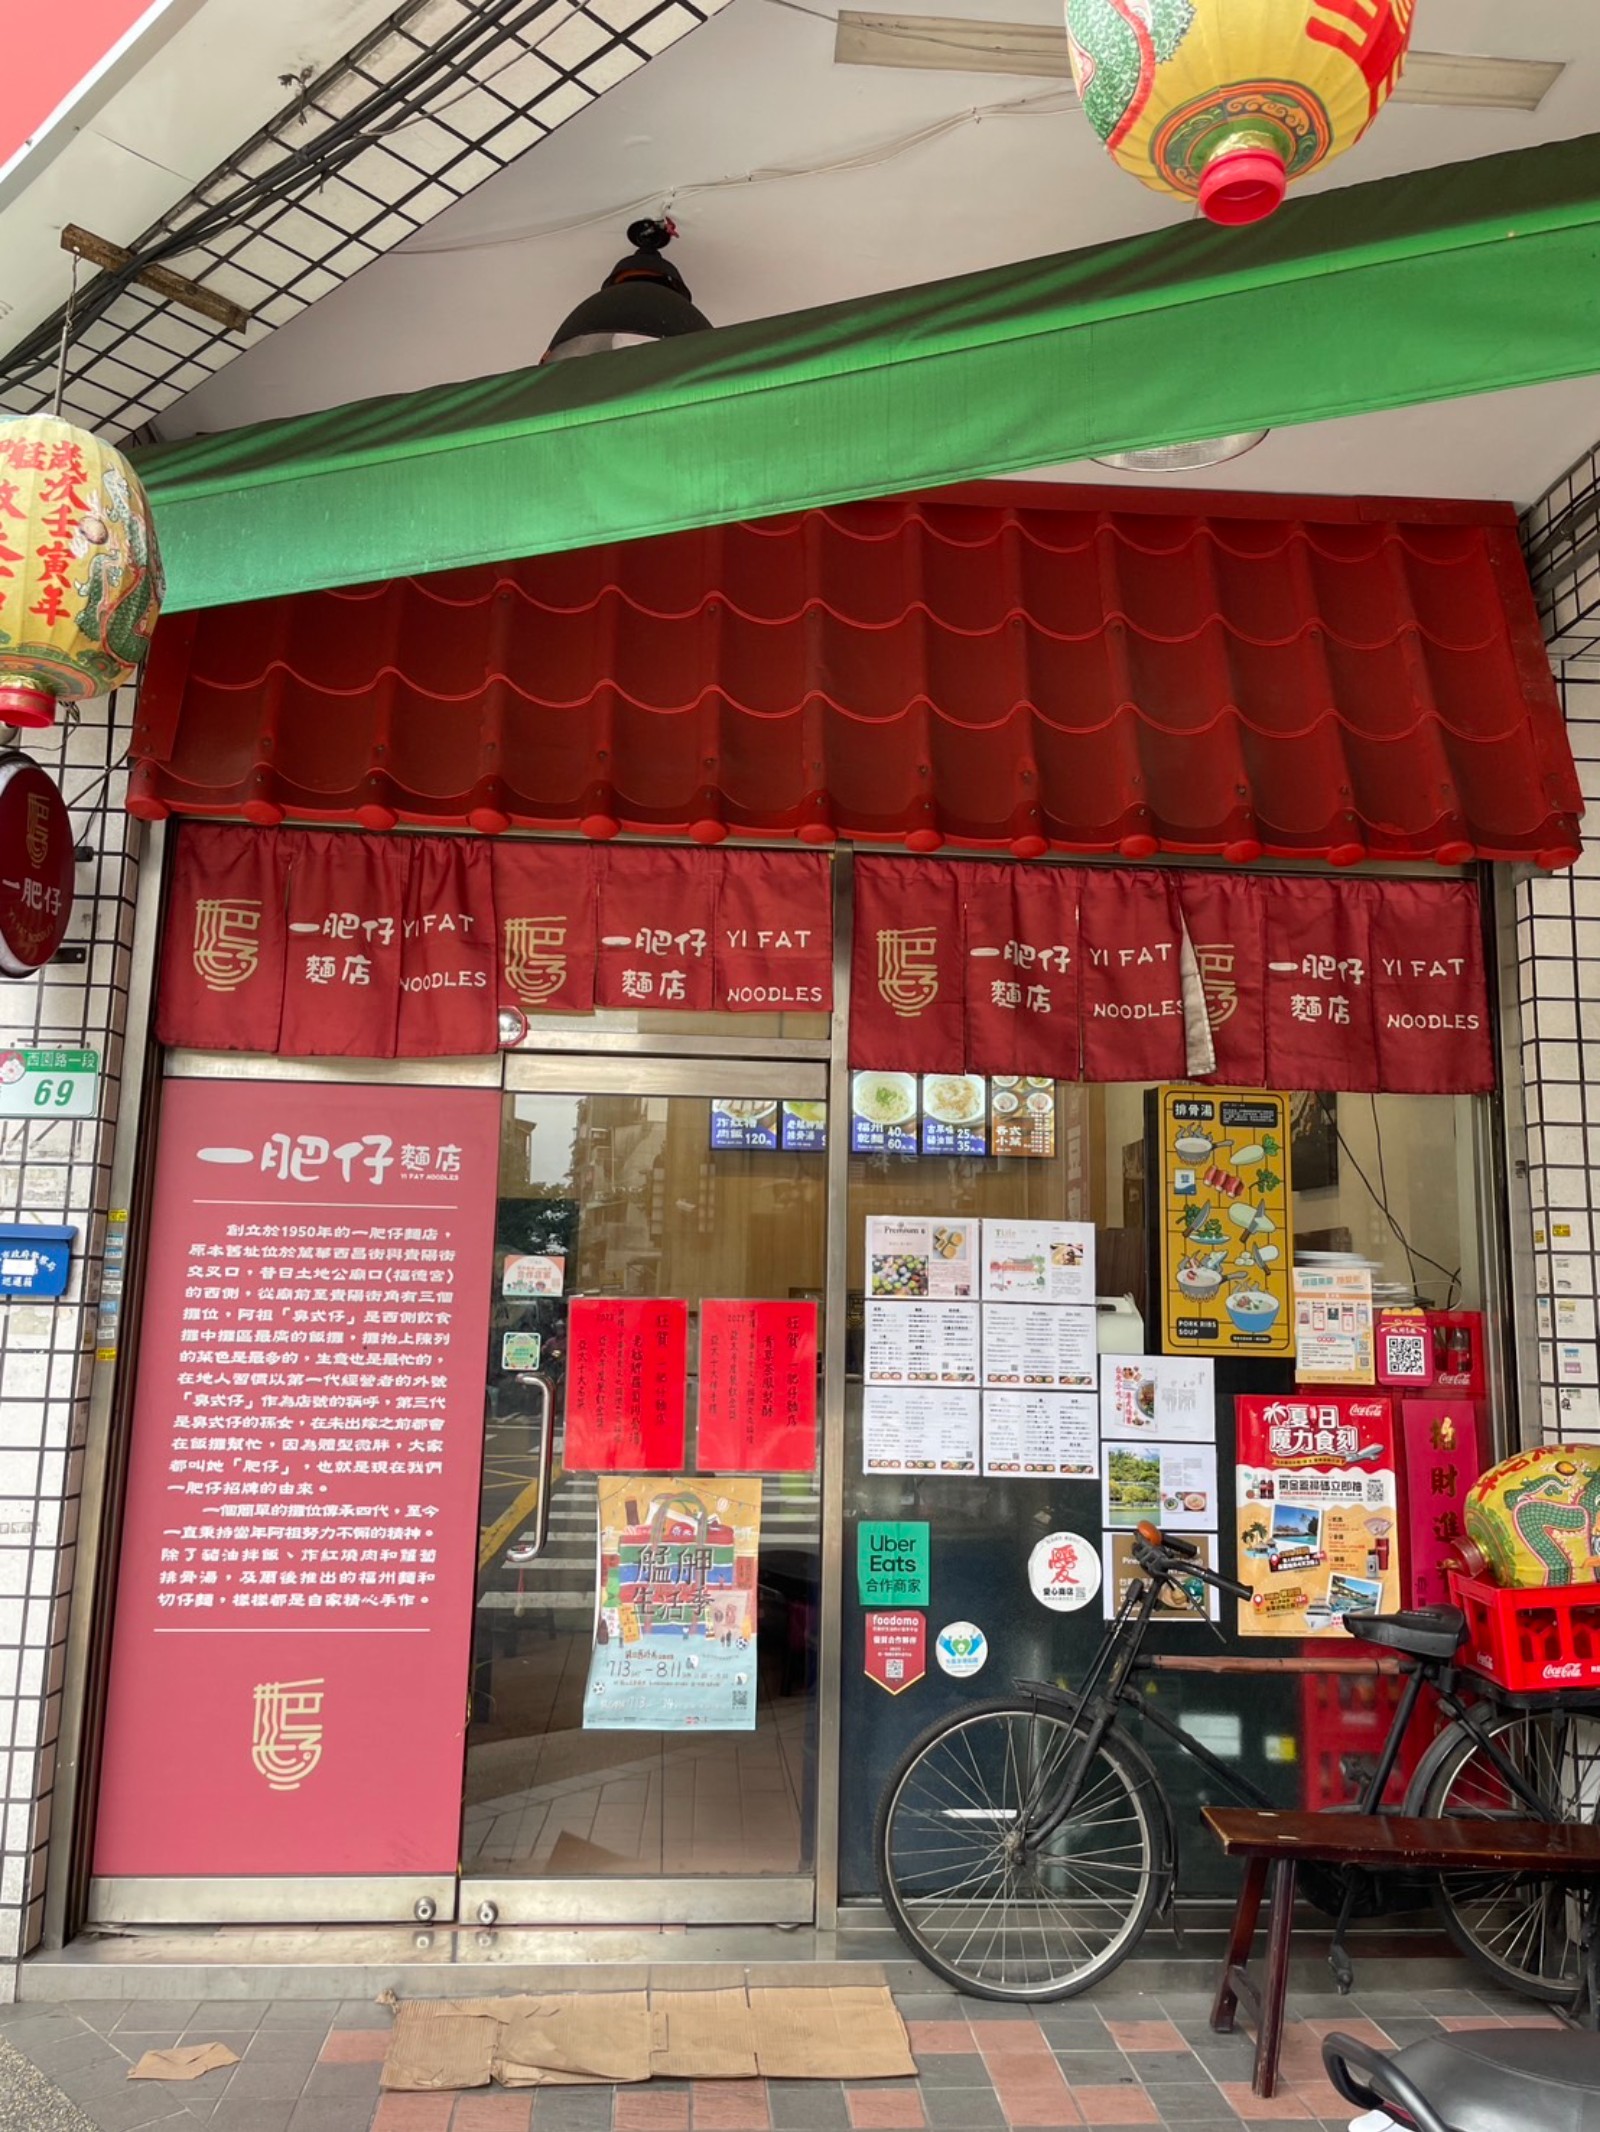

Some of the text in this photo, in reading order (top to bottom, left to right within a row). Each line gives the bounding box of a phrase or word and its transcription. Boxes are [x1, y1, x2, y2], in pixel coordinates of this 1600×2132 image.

[28, 440, 90, 627] 歲次壬寅年
[2, 878, 62, 916] 一肥仔
[289, 913, 394, 946] 一肥仔
[403, 913, 474, 940] YI FAT
[601, 927, 707, 957] 一肥仔
[727, 930, 811, 949] YI FAT
[970, 939, 1071, 974] 一肥仔
[1090, 943, 1172, 967] YI FAT
[305, 954, 372, 986] 麵店
[1268, 953, 1365, 985] 一肥仔
[1382, 958, 1465, 978] YI FAT
[621, 968, 686, 1001] 麵店
[727, 986, 823, 1003] NOODLES
[991, 979, 1051, 1014] 麵店
[1291, 993, 1351, 1025] 麵店
[1387, 1014, 1480, 1030] NOODLES
[26, 1052, 96, 1069] 西園路一段
[34, 1079, 74, 1107] 69
[1175, 1103, 1214, 1118] 排骨湯
[856, 1122, 884, 1133] 福州
[856, 1133, 884, 1145] 乾麵
[996, 1136, 1022, 1147] 小菜
[196, 1133, 463, 1185] 一肥仔 麵店
[1178, 1320, 1198, 1328] PORK
[1178, 1328, 1198, 1336] SOUP
[1289, 1404, 1383, 1428] 夏日 Coca-Cola
[1271, 1427, 1357, 1454] 魔力食刻
[870, 1535, 917, 1552] Uber
[635, 1545, 715, 1586] 艋舺
[870, 1555, 917, 1572] Eats
[866, 1578, 921, 1593] 合作商家
[632, 1587, 716, 1620] 生活季
[873, 1615, 919, 1626] foodomo
[1542, 1663, 1582, 1679] Coca-Cola
